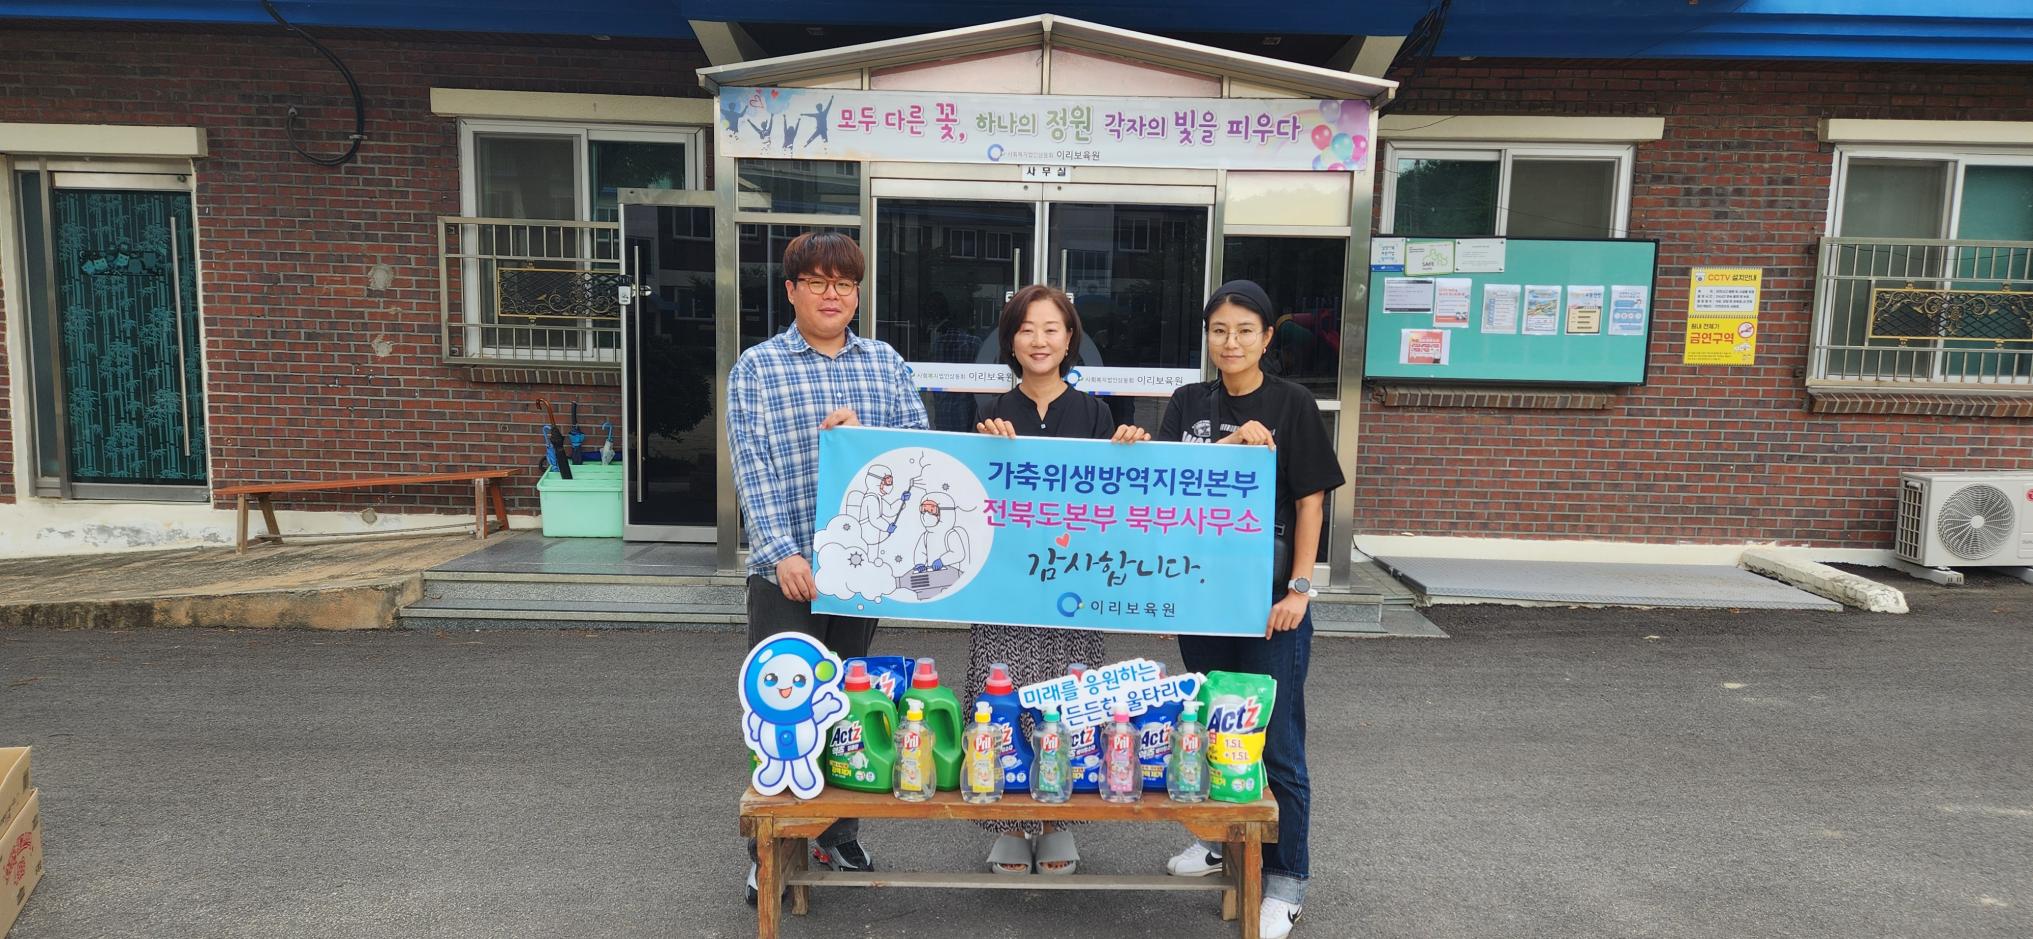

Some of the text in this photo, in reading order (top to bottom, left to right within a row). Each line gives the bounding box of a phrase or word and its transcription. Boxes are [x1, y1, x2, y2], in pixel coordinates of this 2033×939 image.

[838, 102, 1301, 144] 모두 다른 꽃, 하나의 정원 각자의 빛을 피우다
[1056, 150, 1100, 161] 이리보육원
[1690, 332, 1734, 344] 금연구역
[1137, 375, 1183, 387] 이리보육원
[988, 461, 1259, 498] 가축위생방역지원본부
[982, 499, 1263, 536] 전북도본부 북부사무소
[1028, 548, 1206, 587] 감사합니다.
[1090, 600, 1176, 618] 이리보육원
[1023, 663, 1157, 704] 미래를 응원하는
[1125, 681, 1179, 712] 울타리
[904, 734, 919, 747] Pril
[975, 735, 992, 750] Pril
[1042, 735, 1058, 750] Pril
[1114, 735, 1130, 750] Pril
[1183, 735, 1200, 751] Pril
